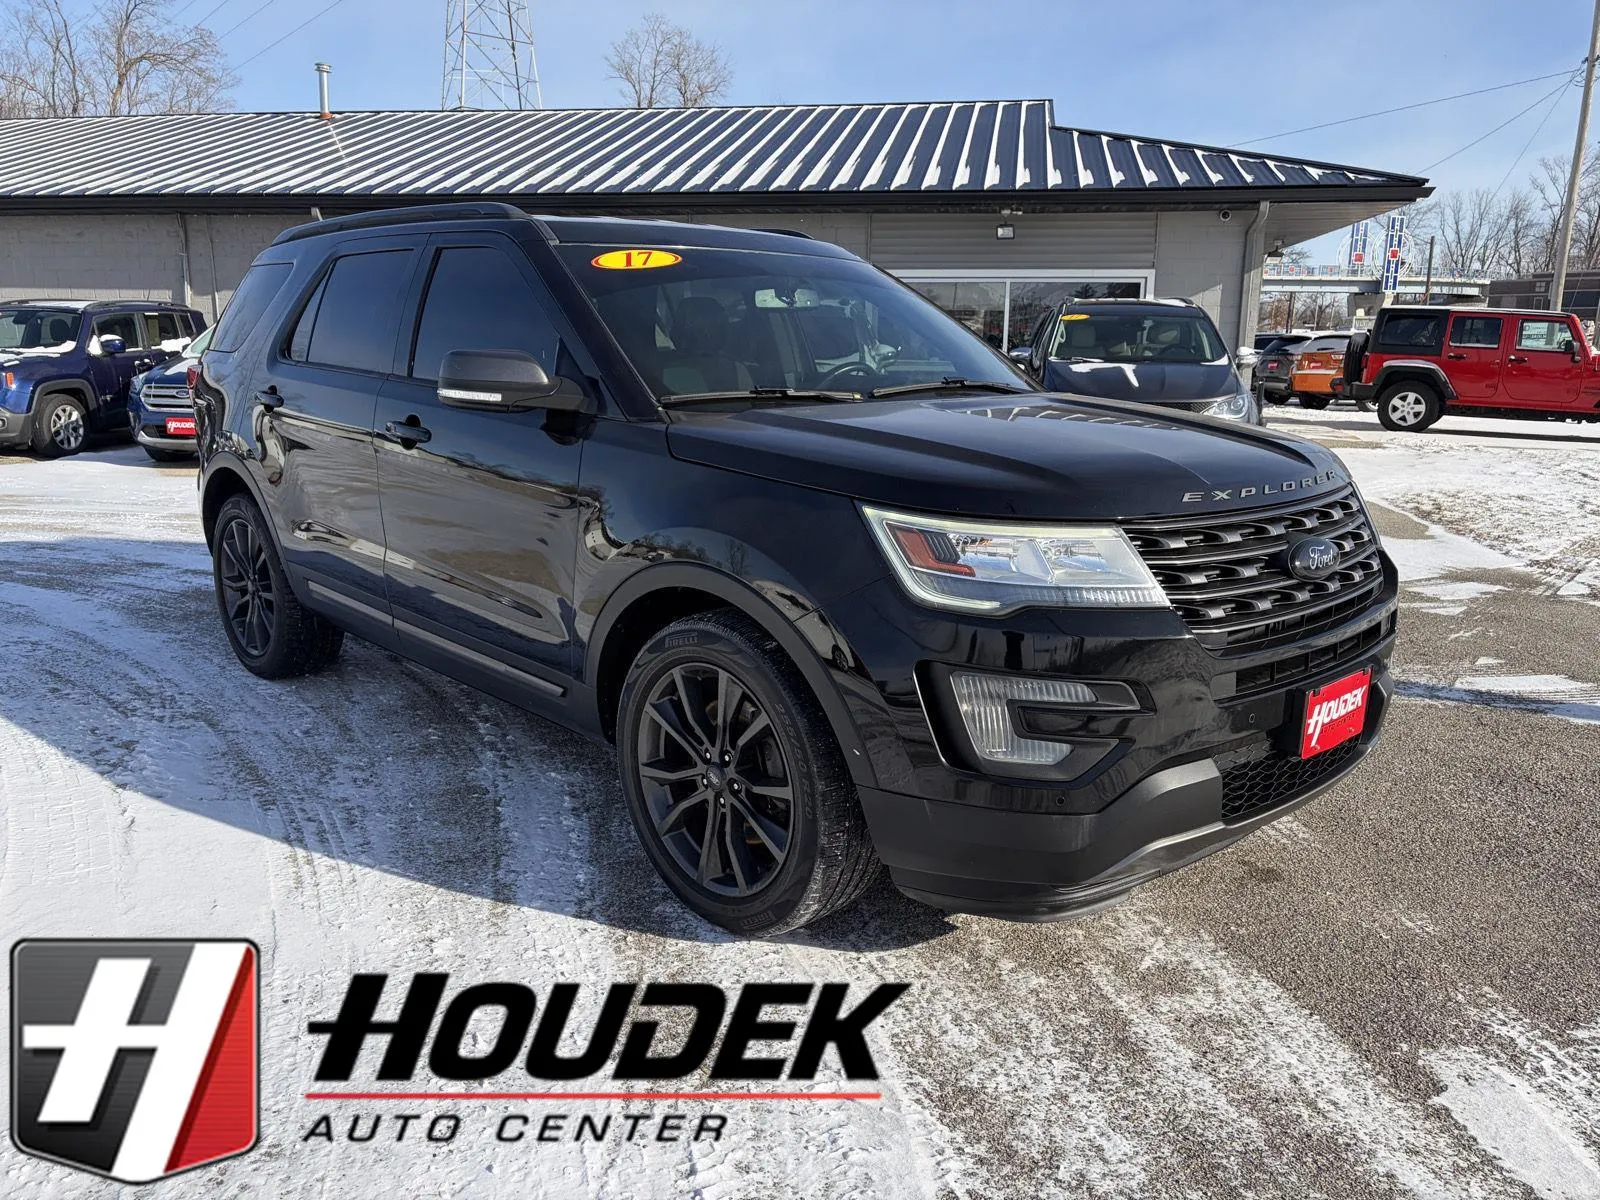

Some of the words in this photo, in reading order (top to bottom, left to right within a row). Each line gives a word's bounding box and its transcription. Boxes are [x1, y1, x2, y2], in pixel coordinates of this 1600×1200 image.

[624, 251, 653, 268] 17
[1182, 469, 1338, 502] EXPLORER
[1309, 546, 1335, 570] Ford
[1307, 685, 1367, 748] HOUDEK
